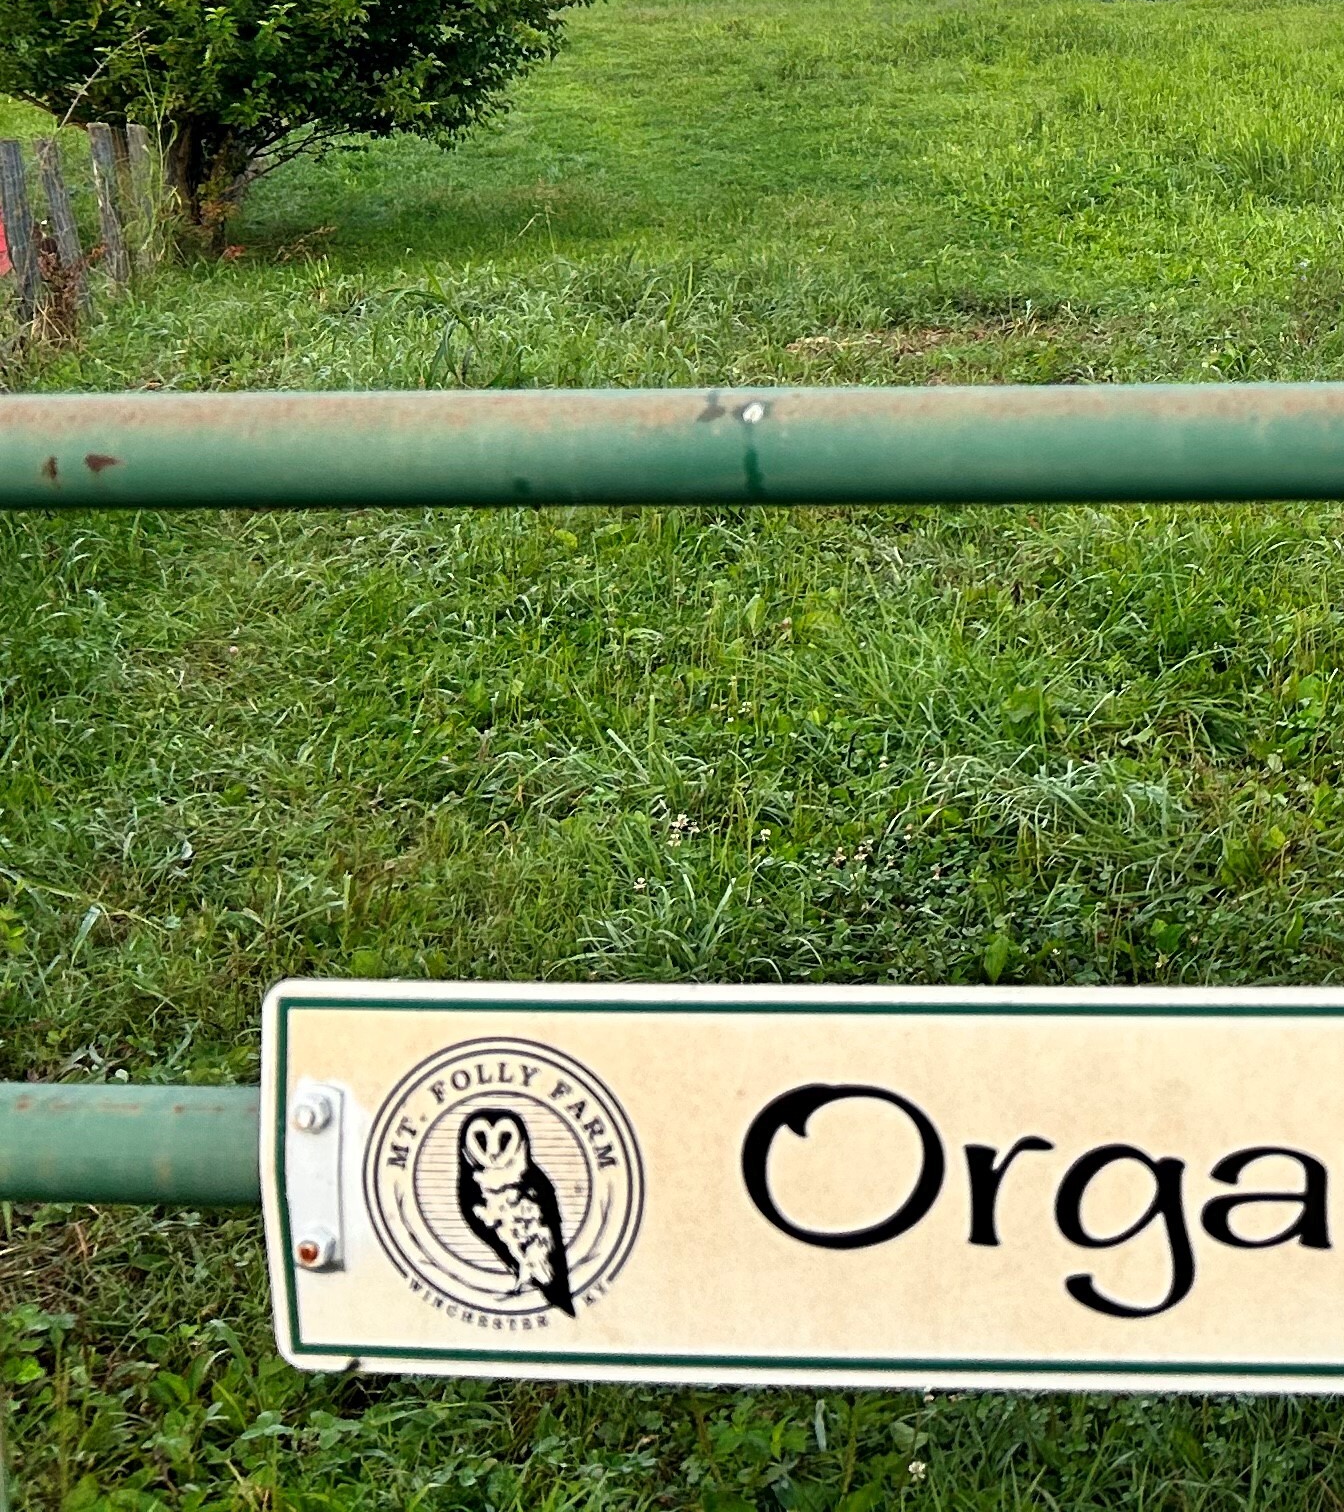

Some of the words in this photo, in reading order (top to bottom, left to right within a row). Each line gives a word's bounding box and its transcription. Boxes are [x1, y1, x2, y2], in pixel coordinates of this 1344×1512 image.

[386, 1115, 428, 1171] MT.
[429, 1062, 541, 1104] FOLLY
[548, 1079, 618, 1171] FARM
[408, 1278, 550, 1330] WINCHESTER
